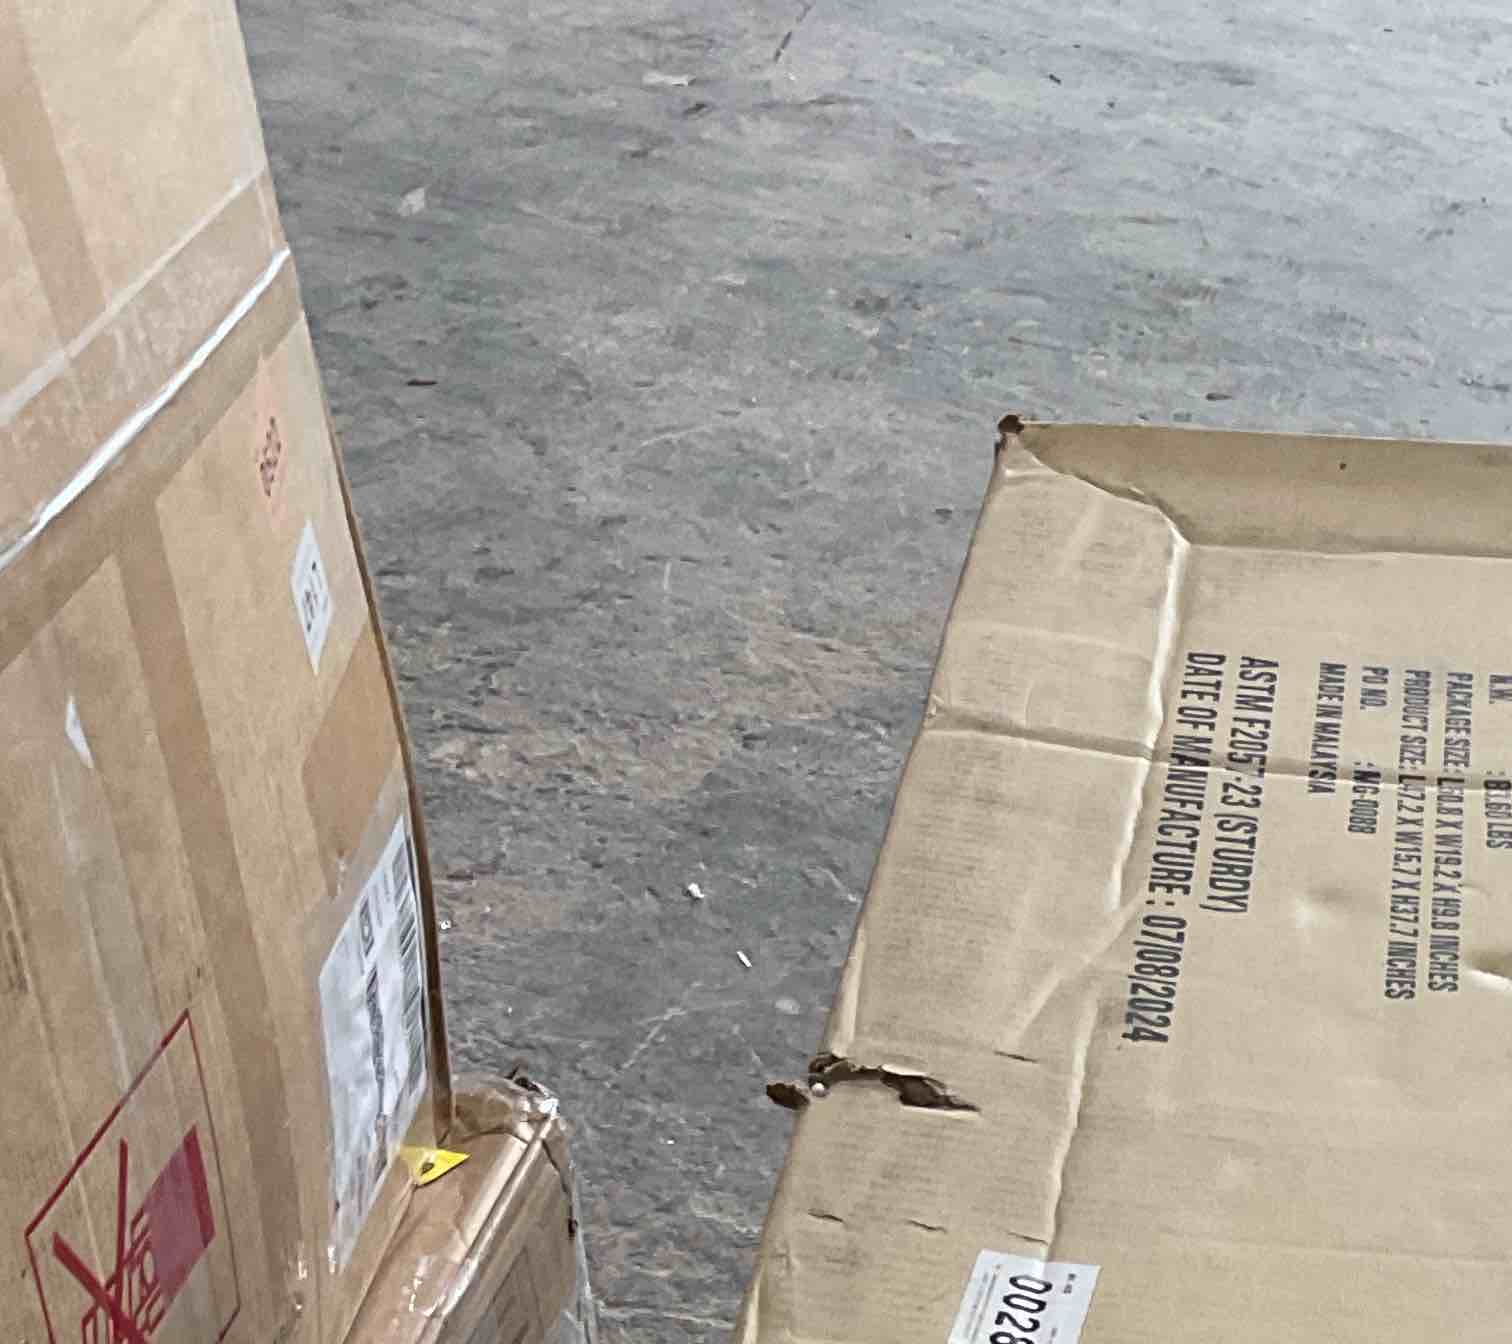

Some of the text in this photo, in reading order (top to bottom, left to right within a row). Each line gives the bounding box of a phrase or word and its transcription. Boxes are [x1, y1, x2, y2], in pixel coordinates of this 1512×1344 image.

[1181, 652, 1226, 701] DATE
[1362, 666, 1388, 685] PO
[1176, 706, 1218, 731] OF
[1359, 687, 1388, 711] NO.
[1403, 669, 1431, 731] PRODUCT
[1445, 671, 1473, 735] PACKAGE
[1307, 662, 1347, 795] MADE IN MALAYSIA
[1198, 656, 1279, 913] ASTM F2057-23 (STURDY)
[1147, 736, 1213, 896] MANUFACTURE
[1396, 816, 1424, 828] X
[1436, 819, 1463, 830] X
[1392, 831, 1423, 877] W15.7
[1434, 834, 1462, 880] W19.2
[1391, 879, 1421, 891] X
[1433, 883, 1461, 895] X
[1389, 894, 1420, 938] H37.7
[1430, 897, 1461, 931] H9.8
[1121, 915, 1188, 1045] 07/08/2024
[1384, 941, 1418, 1000] INCHES
[1427, 935, 1460, 993] INCHES
